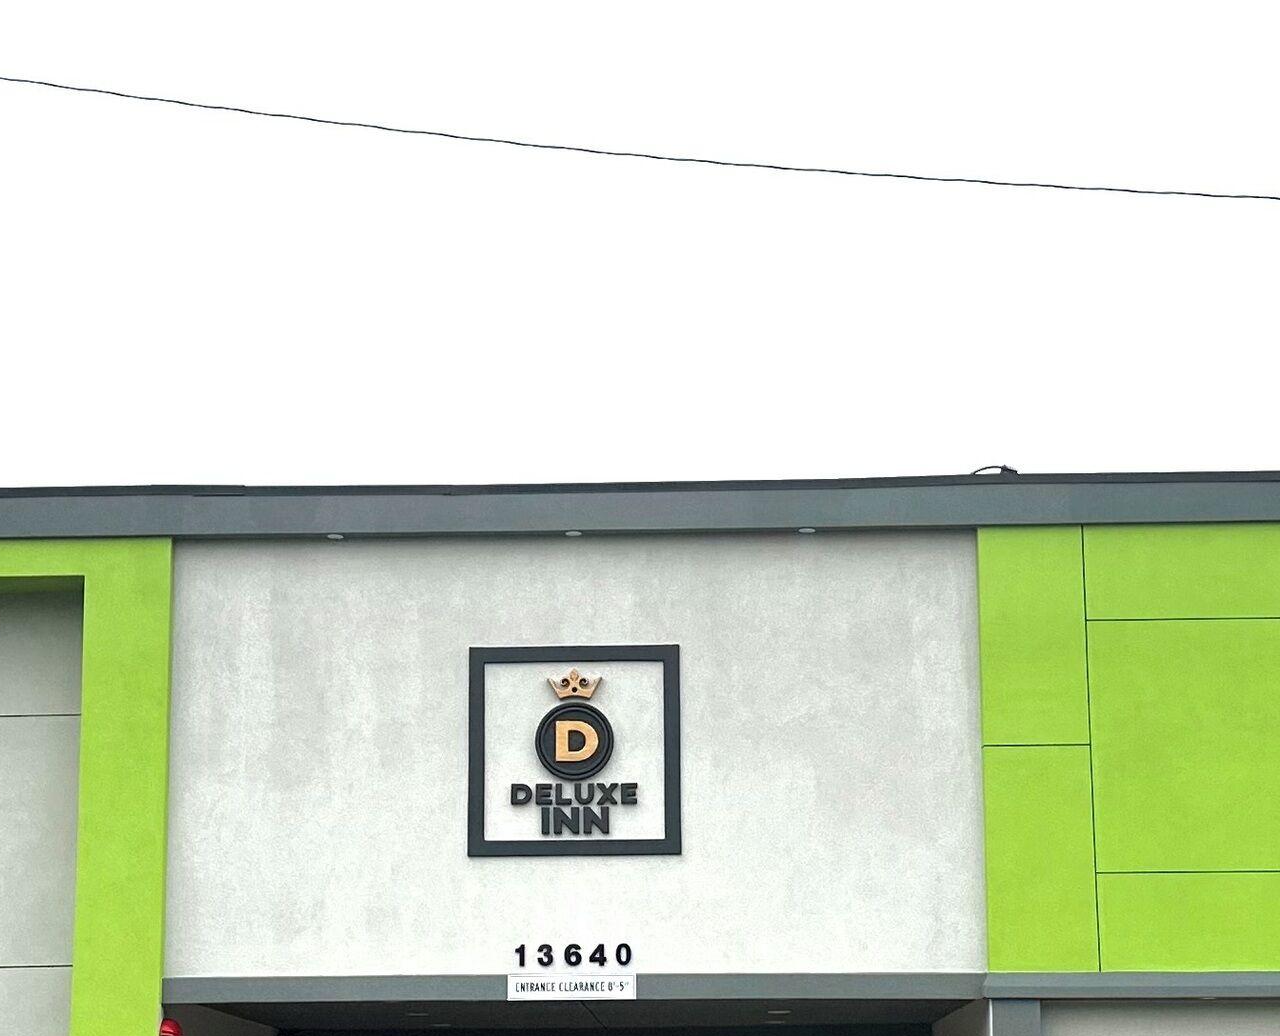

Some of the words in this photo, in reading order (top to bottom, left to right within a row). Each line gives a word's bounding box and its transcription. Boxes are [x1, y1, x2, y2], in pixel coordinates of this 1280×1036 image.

[555, 720, 599, 762] D
[510, 782, 638, 806] DELUXE
[540, 806, 611, 836] INN
[514, 943, 633, 967] 13640
[515, 981, 556, 993] ENTRANCE
[558, 981, 605, 992] CLEARANCE
